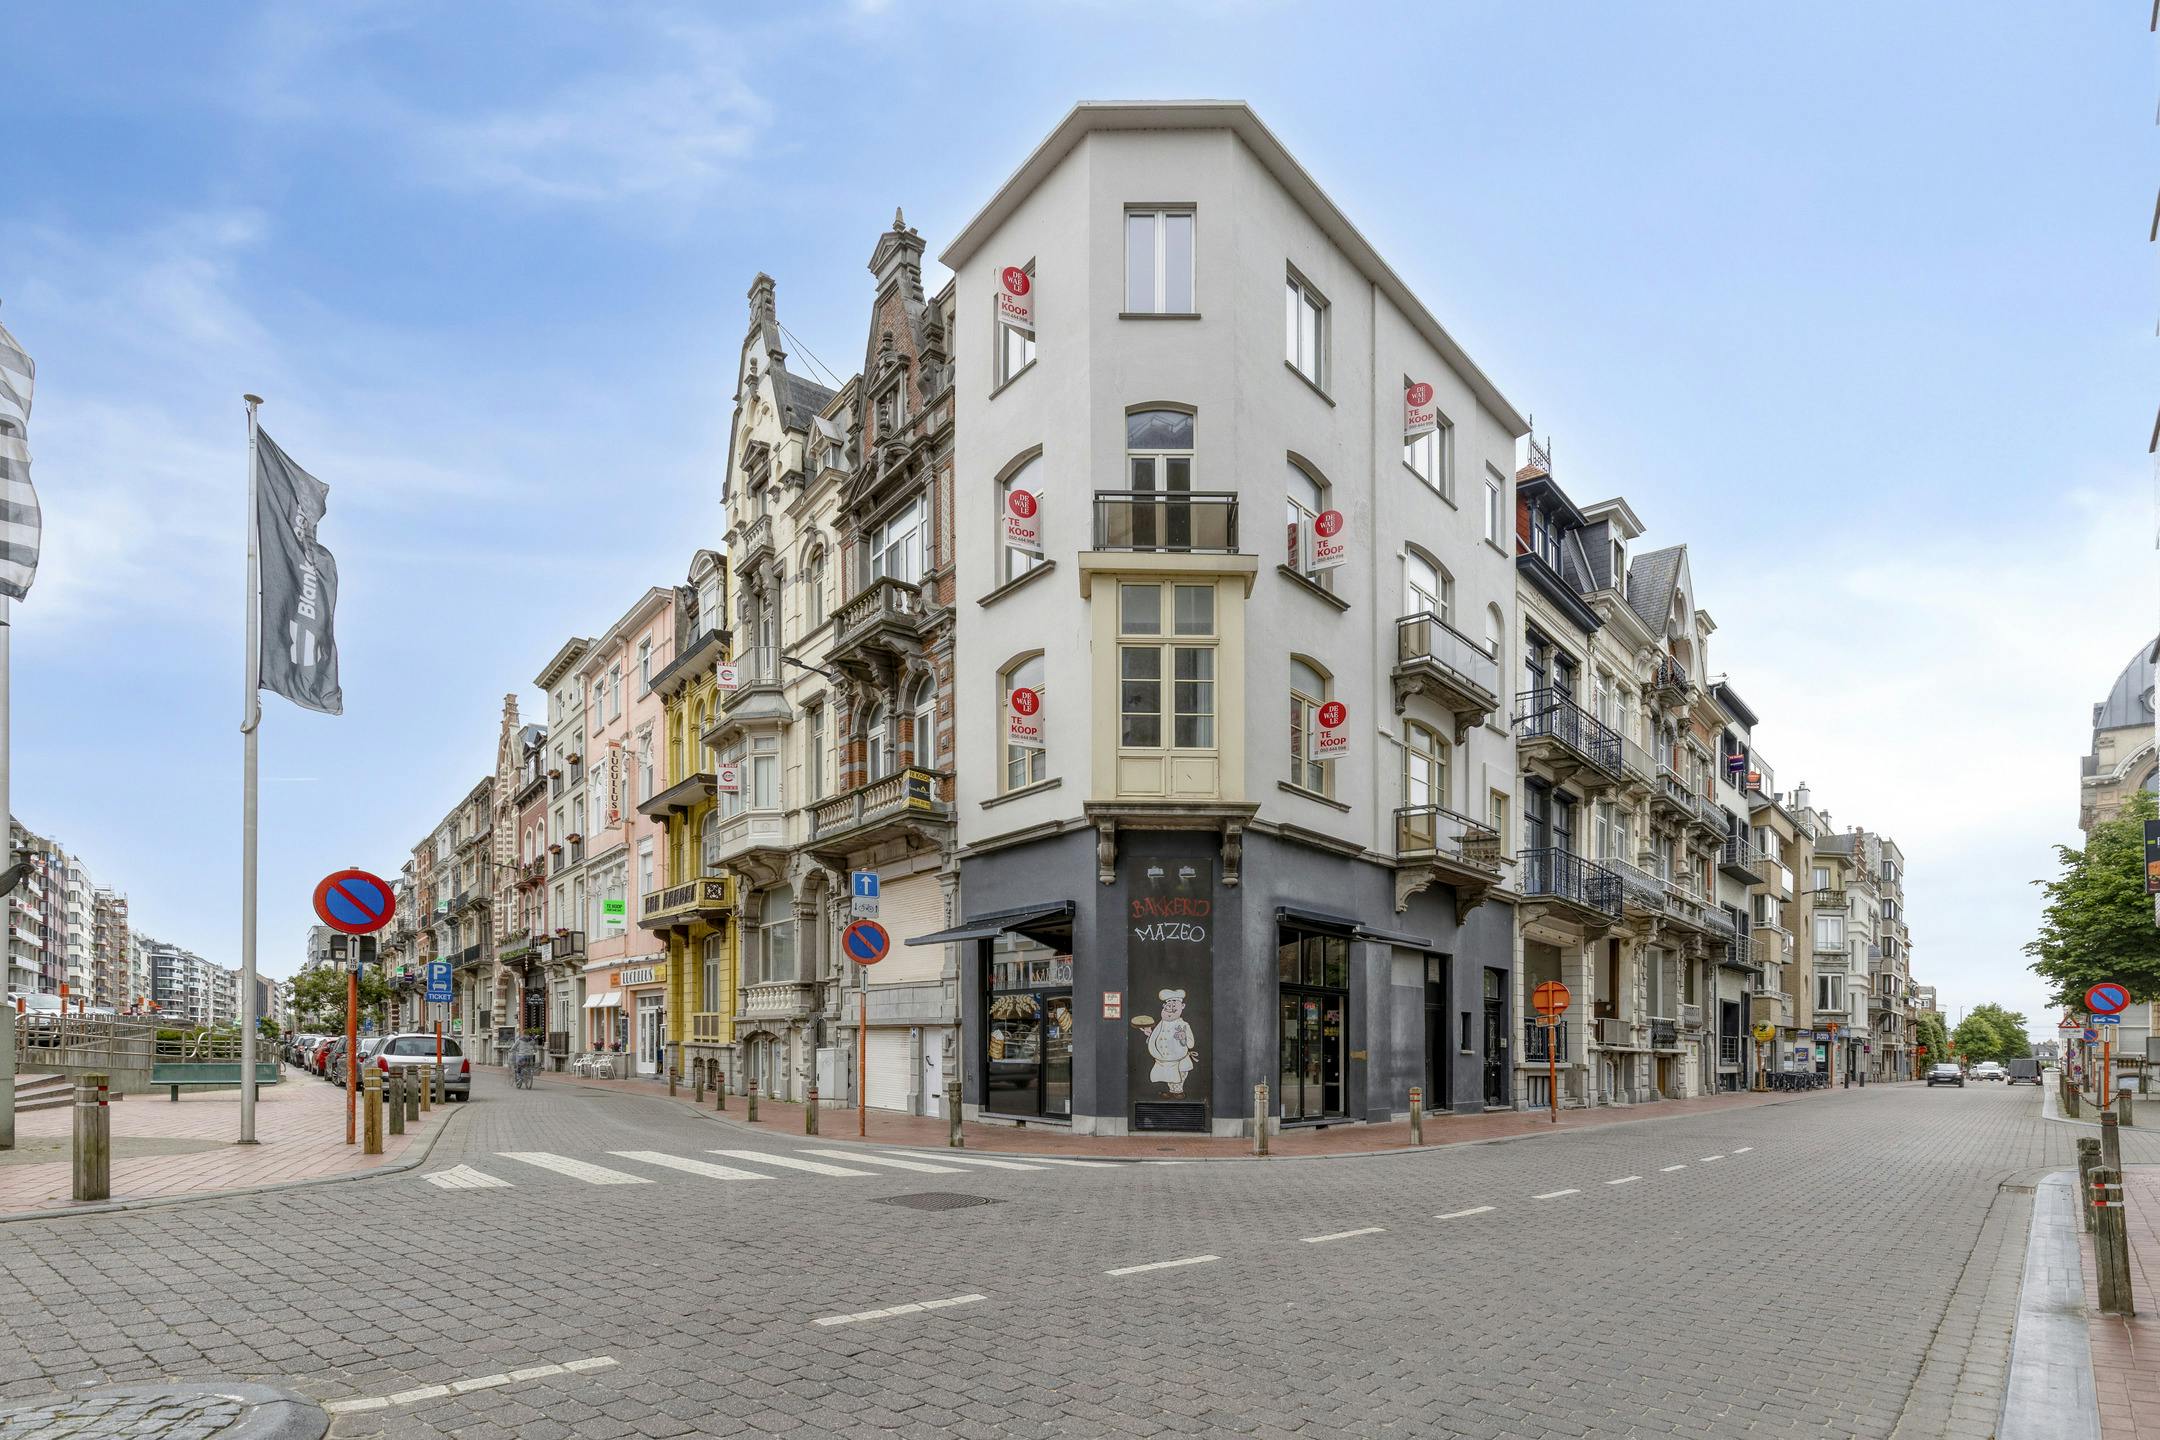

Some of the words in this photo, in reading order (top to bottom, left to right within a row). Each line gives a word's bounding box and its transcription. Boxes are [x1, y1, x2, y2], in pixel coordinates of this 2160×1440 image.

[1013, 272, 1022, 280] DE
[1002, 293, 1012, 303] TE
[1002, 302, 1027, 316] KOOP
[1409, 414, 1433, 424] KOOP
[1008, 517, 1020, 526] TE
[1009, 526, 1034, 537] KOOP
[1317, 540, 1328, 548] TE
[1318, 546, 1344, 557] KOOP
[1011, 716, 1022, 724] TE
[1012, 725, 1037, 734] KOOP
[1321, 738, 1346, 747] KOOP
[1134, 922, 1205, 942] MAZEO
[434, 965, 446, 980] P
[622, 970, 652, 984] LUCULLUS
